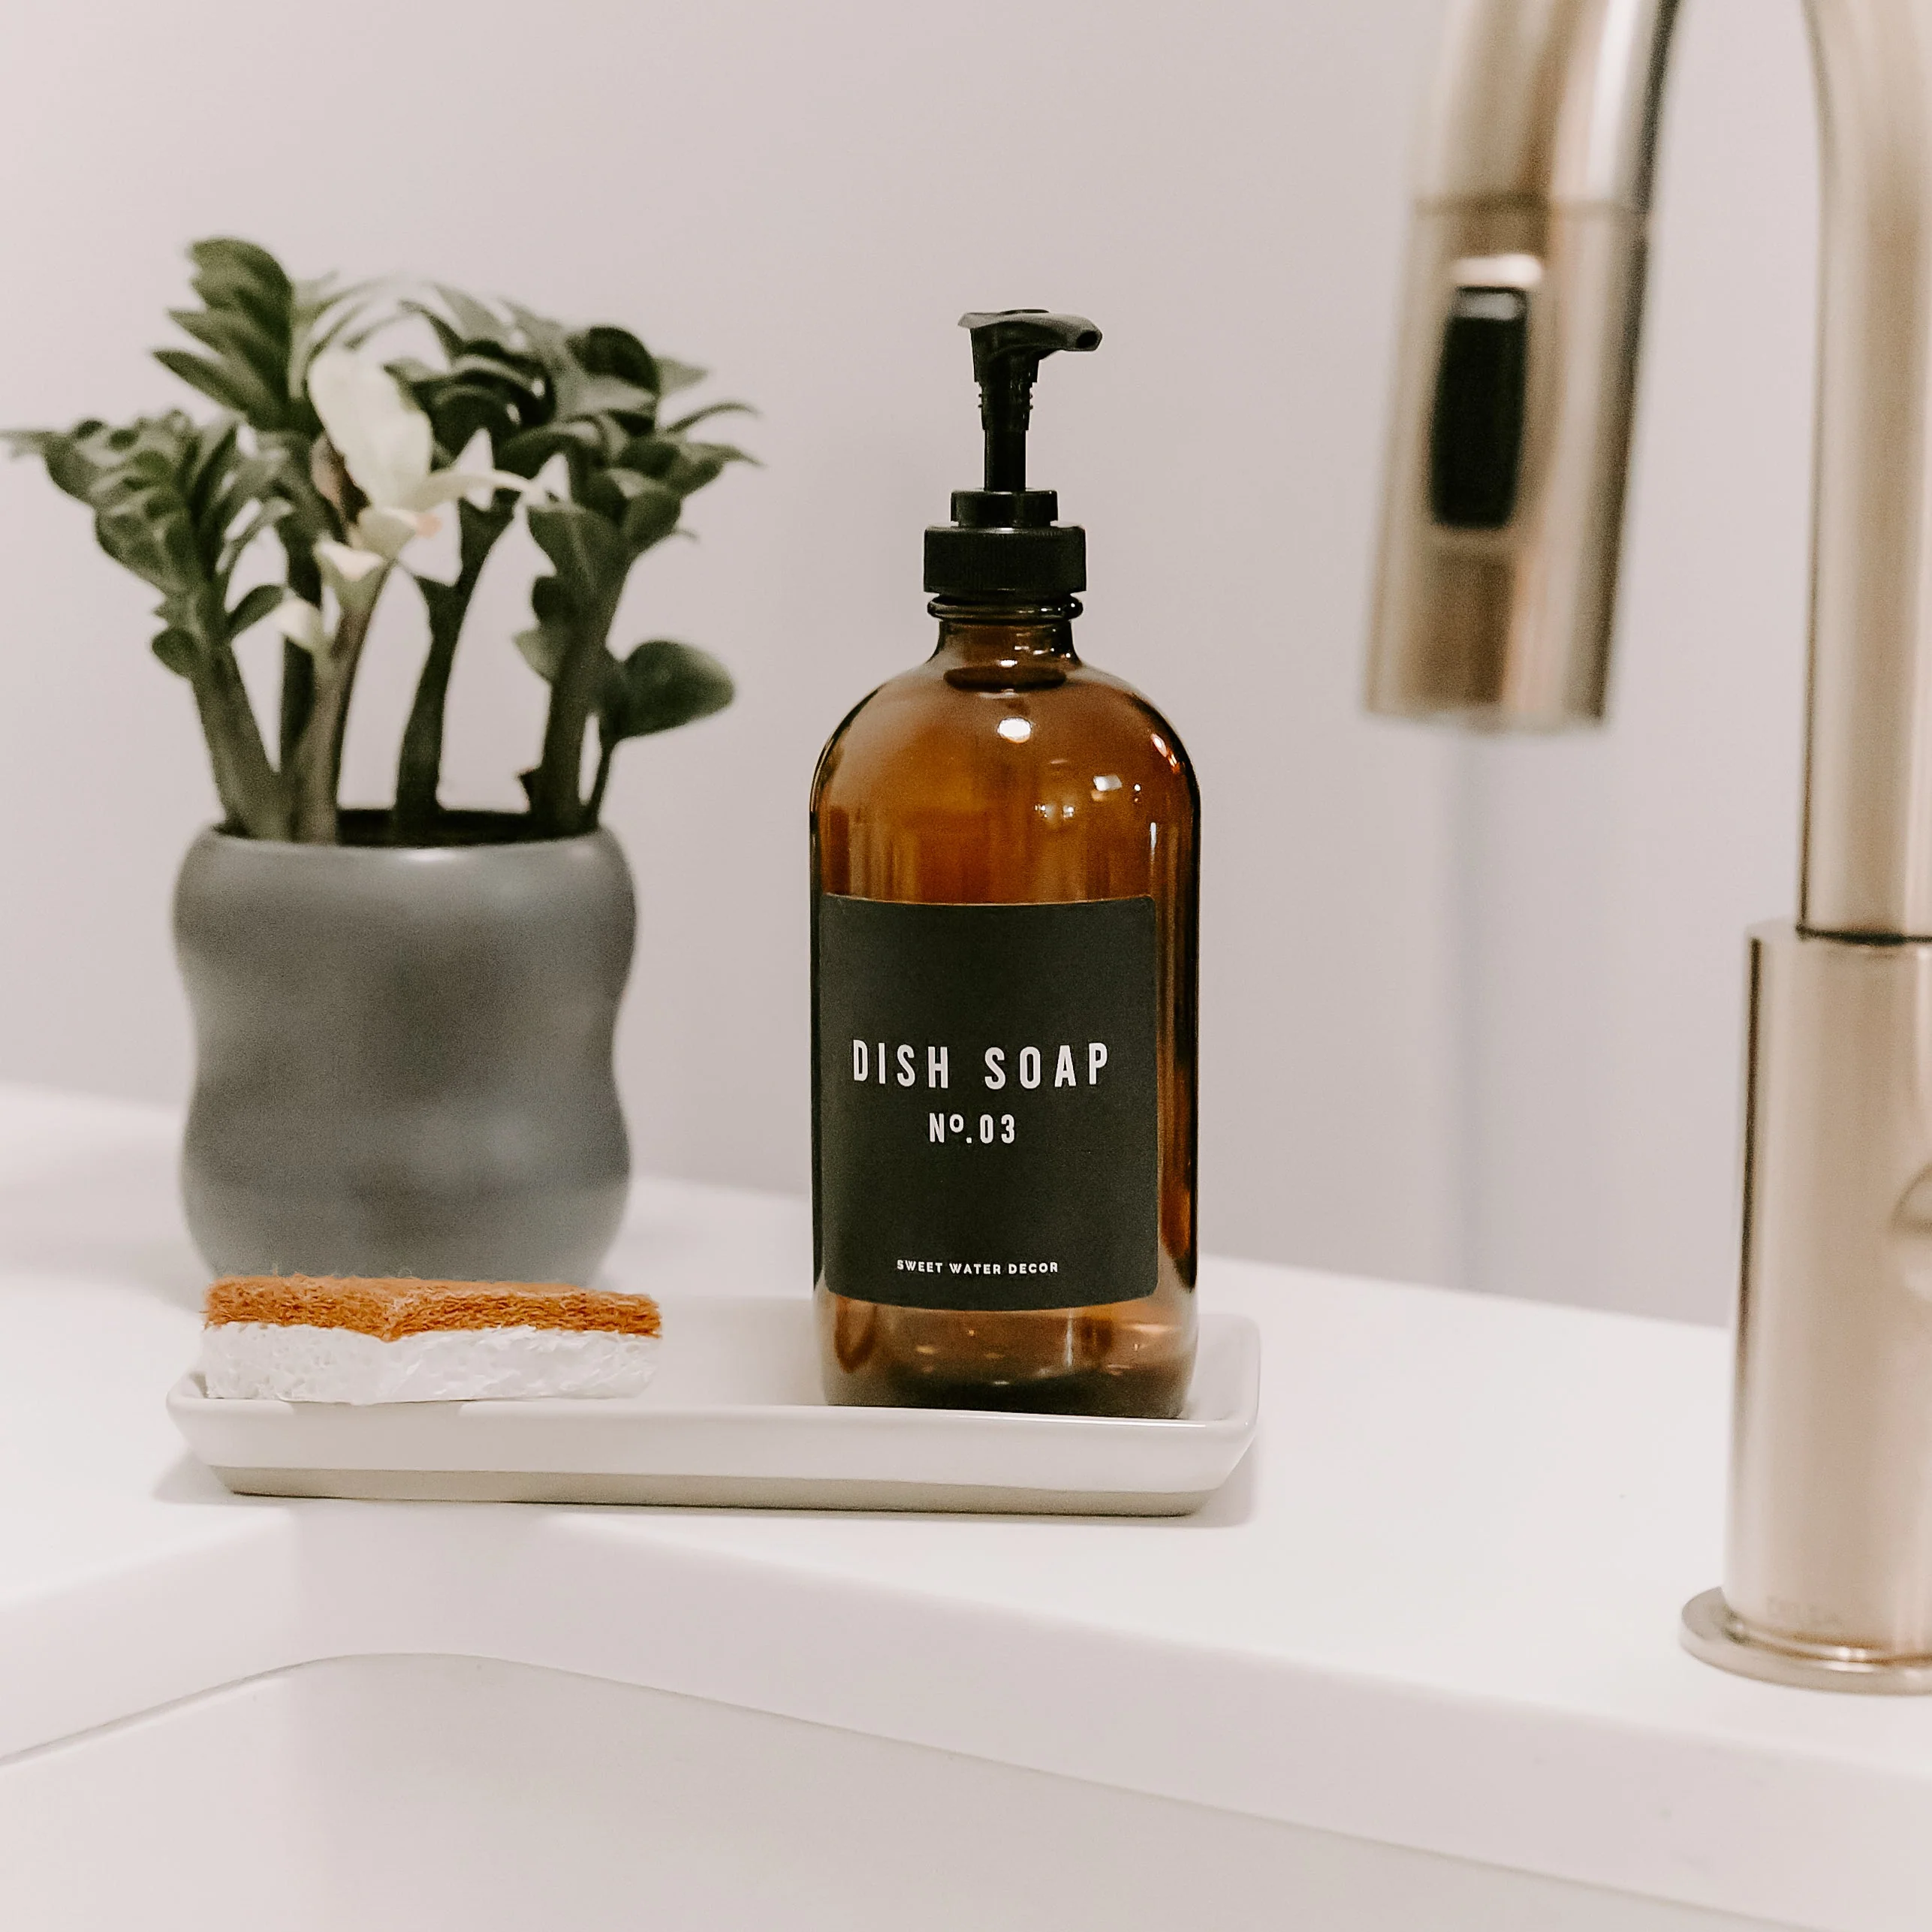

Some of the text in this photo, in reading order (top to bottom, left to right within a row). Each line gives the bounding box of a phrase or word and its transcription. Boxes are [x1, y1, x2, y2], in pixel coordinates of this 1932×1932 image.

[853, 1039, 1108, 1090] DISH SOAP
[897, 1259, 1058, 1275] SWEET WATER DECOR
